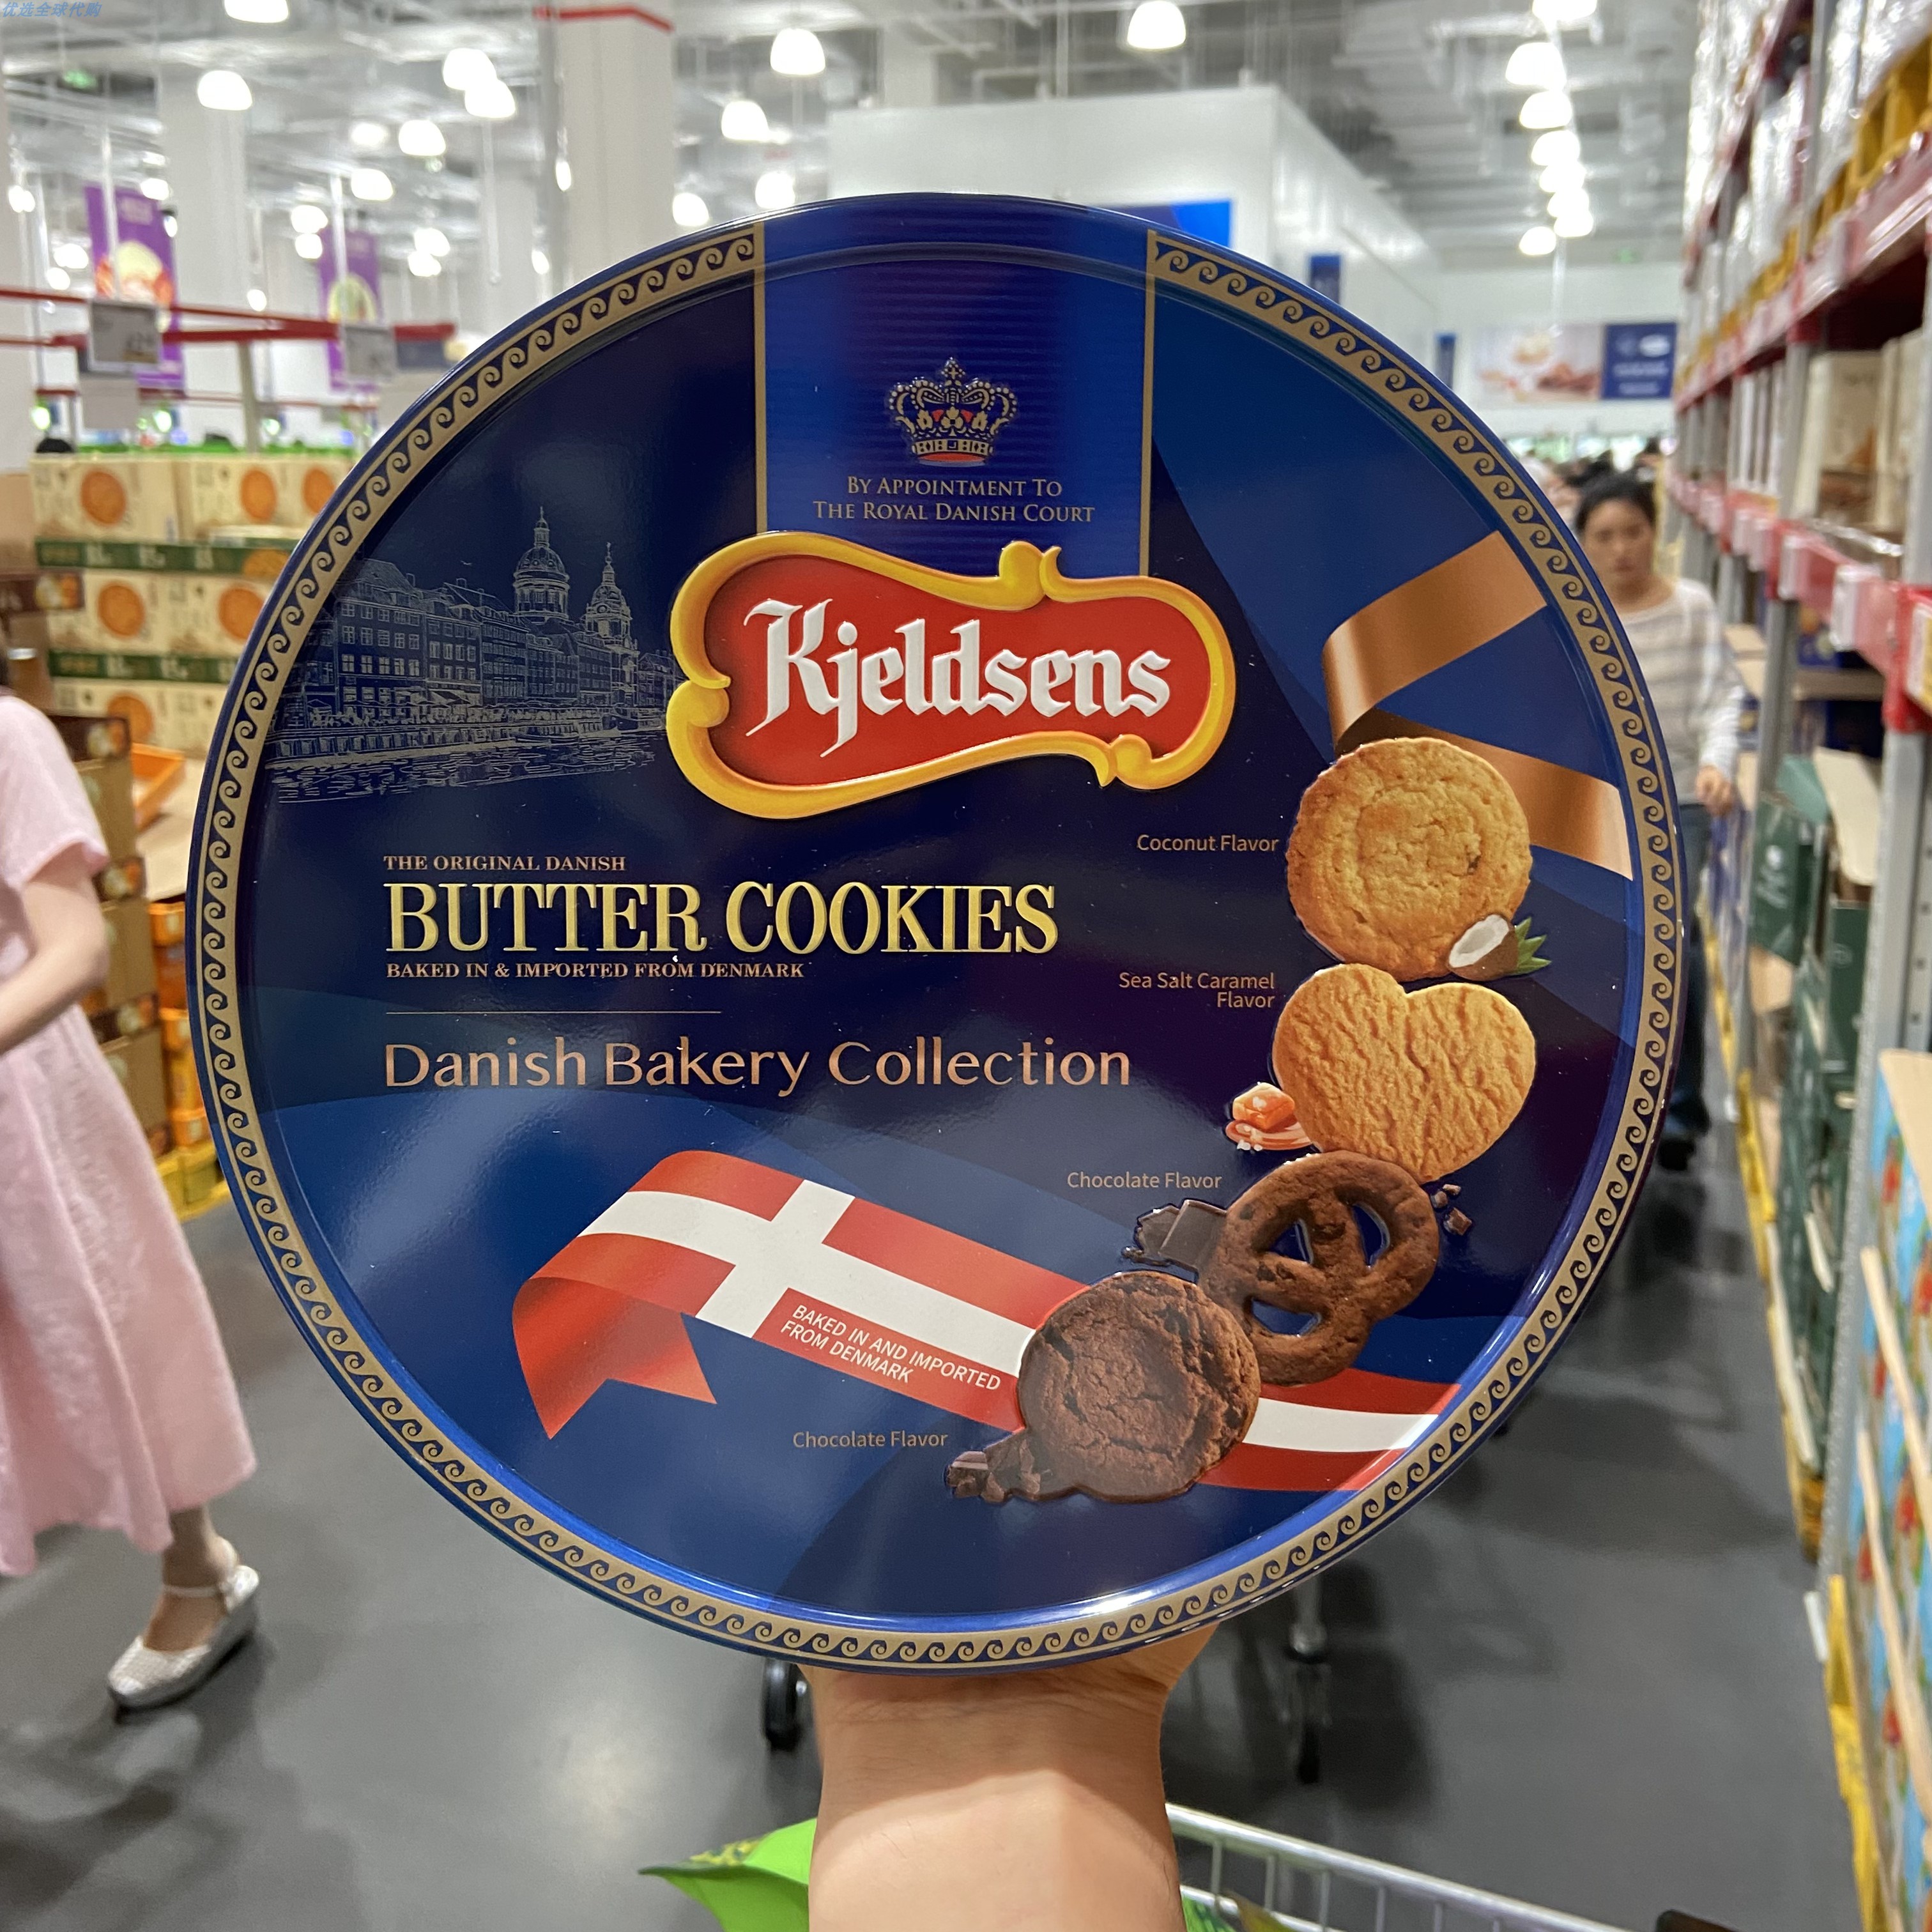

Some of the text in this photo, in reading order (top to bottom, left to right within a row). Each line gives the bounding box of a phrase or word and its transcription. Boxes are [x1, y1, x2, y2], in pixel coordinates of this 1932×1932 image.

[743, 598, 1171, 758] Kjeldsens
[1137, 834, 1279, 852] Coconut Flavor
[384, 855, 626, 871] THE ORIGINAL DANISH
[383, 881, 1058, 954] BUTTER COOKIES
[386, 963, 804, 978] BAKED IN & IMPORTED FROM DENMARK
[1119, 972, 1275, 989] Sea Salt Caramel
[1217, 992, 1275, 1008] Flavor
[385, 1036, 1130, 1097] Danish Bakery Collection
[1067, 1171, 1222, 1188] Chocolate Flavor
[780, 1321, 914, 1383] FROM DENMARK
[792, 1305, 1001, 1391] BAKED IN AND IMPORTED
[793, 1430, 948, 1448] Chocolate Flavor
